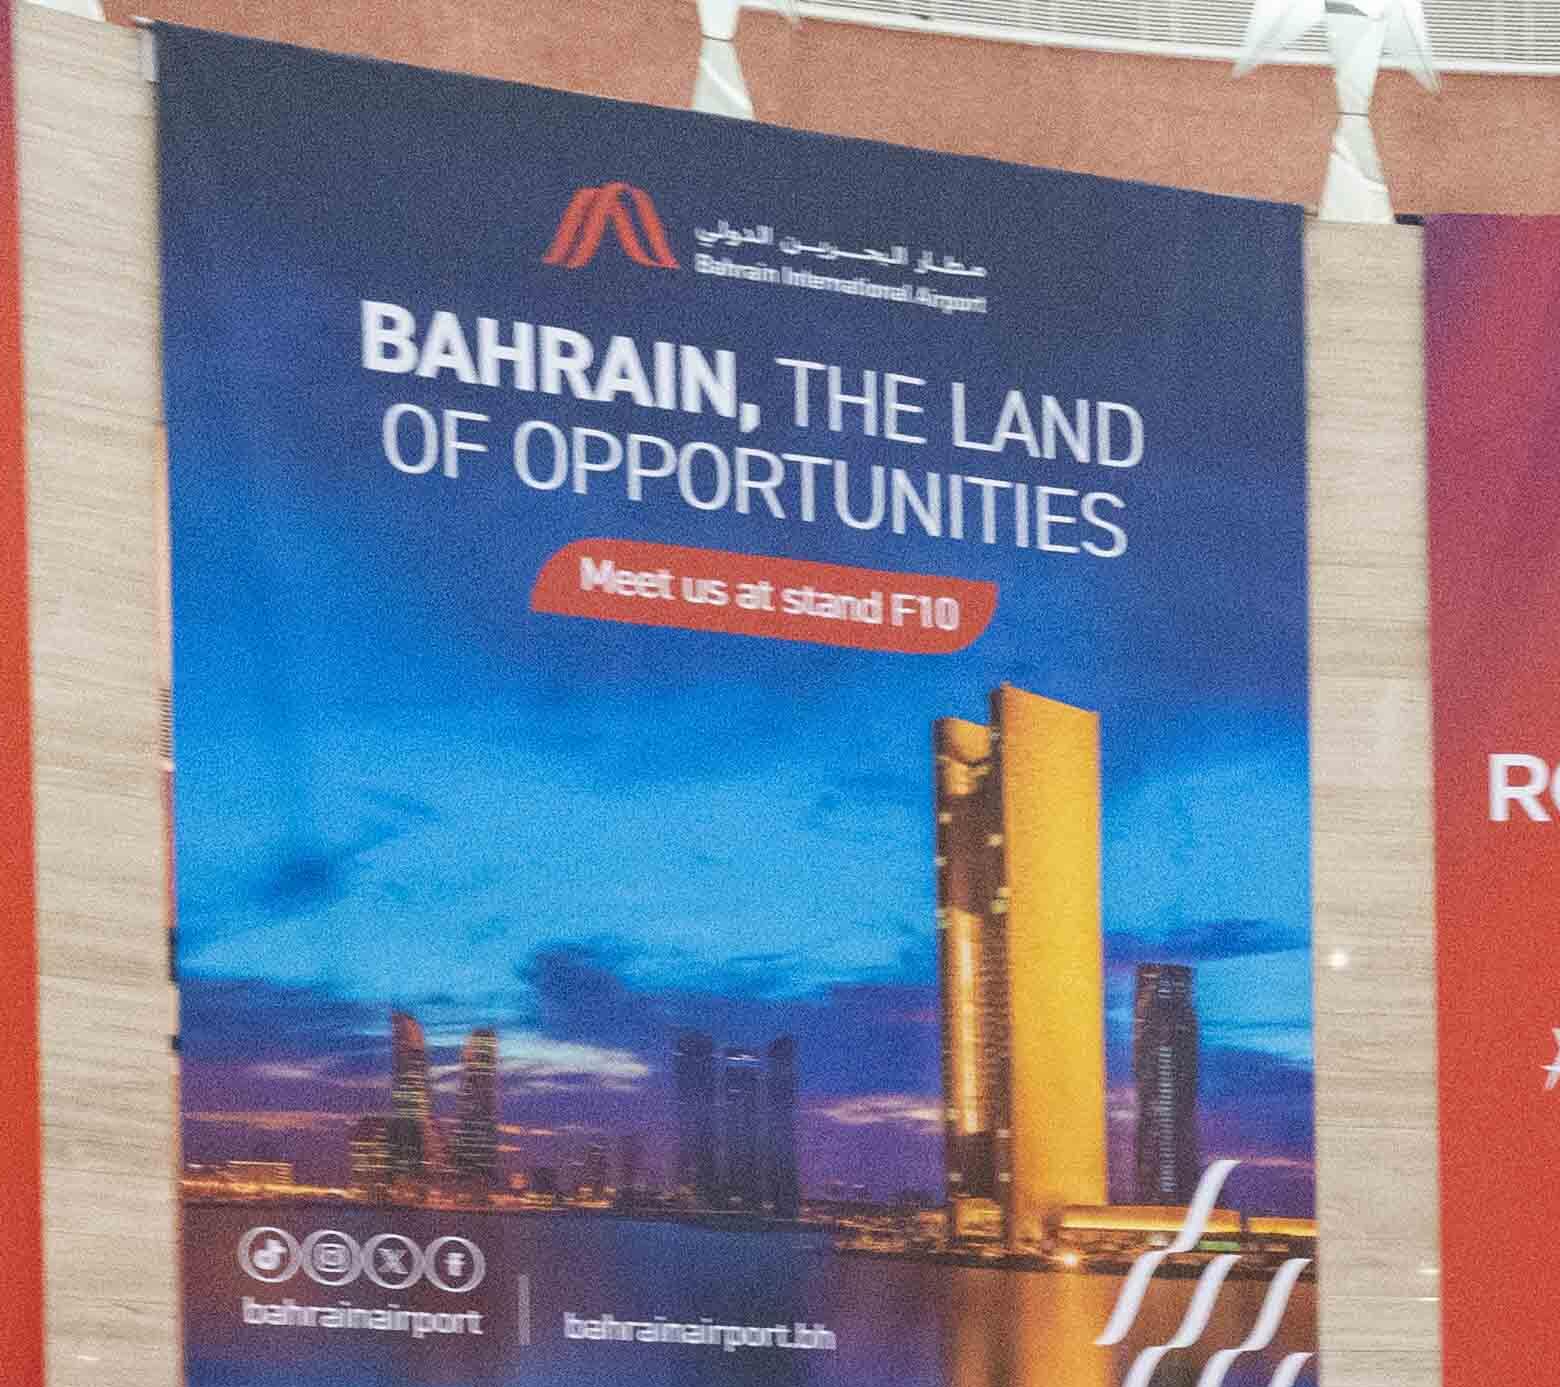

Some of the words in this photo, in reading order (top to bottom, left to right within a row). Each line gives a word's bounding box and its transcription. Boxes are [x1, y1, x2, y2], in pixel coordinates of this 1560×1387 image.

[694, 253, 780, 283] Bahrain
[781, 266, 912, 301] International
[914, 286, 987, 314] Airport
[361, 299, 761, 433] BAHRAIN,
[777, 357, 926, 445] THE
[952, 381, 1145, 469] LAND
[382, 402, 490, 479] OF
[513, 418, 1129, 559] OPPORTUNITIES
[580, 556, 676, 602] Meet
[683, 571, 730, 608] us
[737, 576, 774, 611] at
[782, 580, 883, 626] stand
[892, 591, 960, 632] F10
[242, 1297, 484, 1338] bahrainairport
[563, 1312, 836, 1351] bahrainairport.bh
